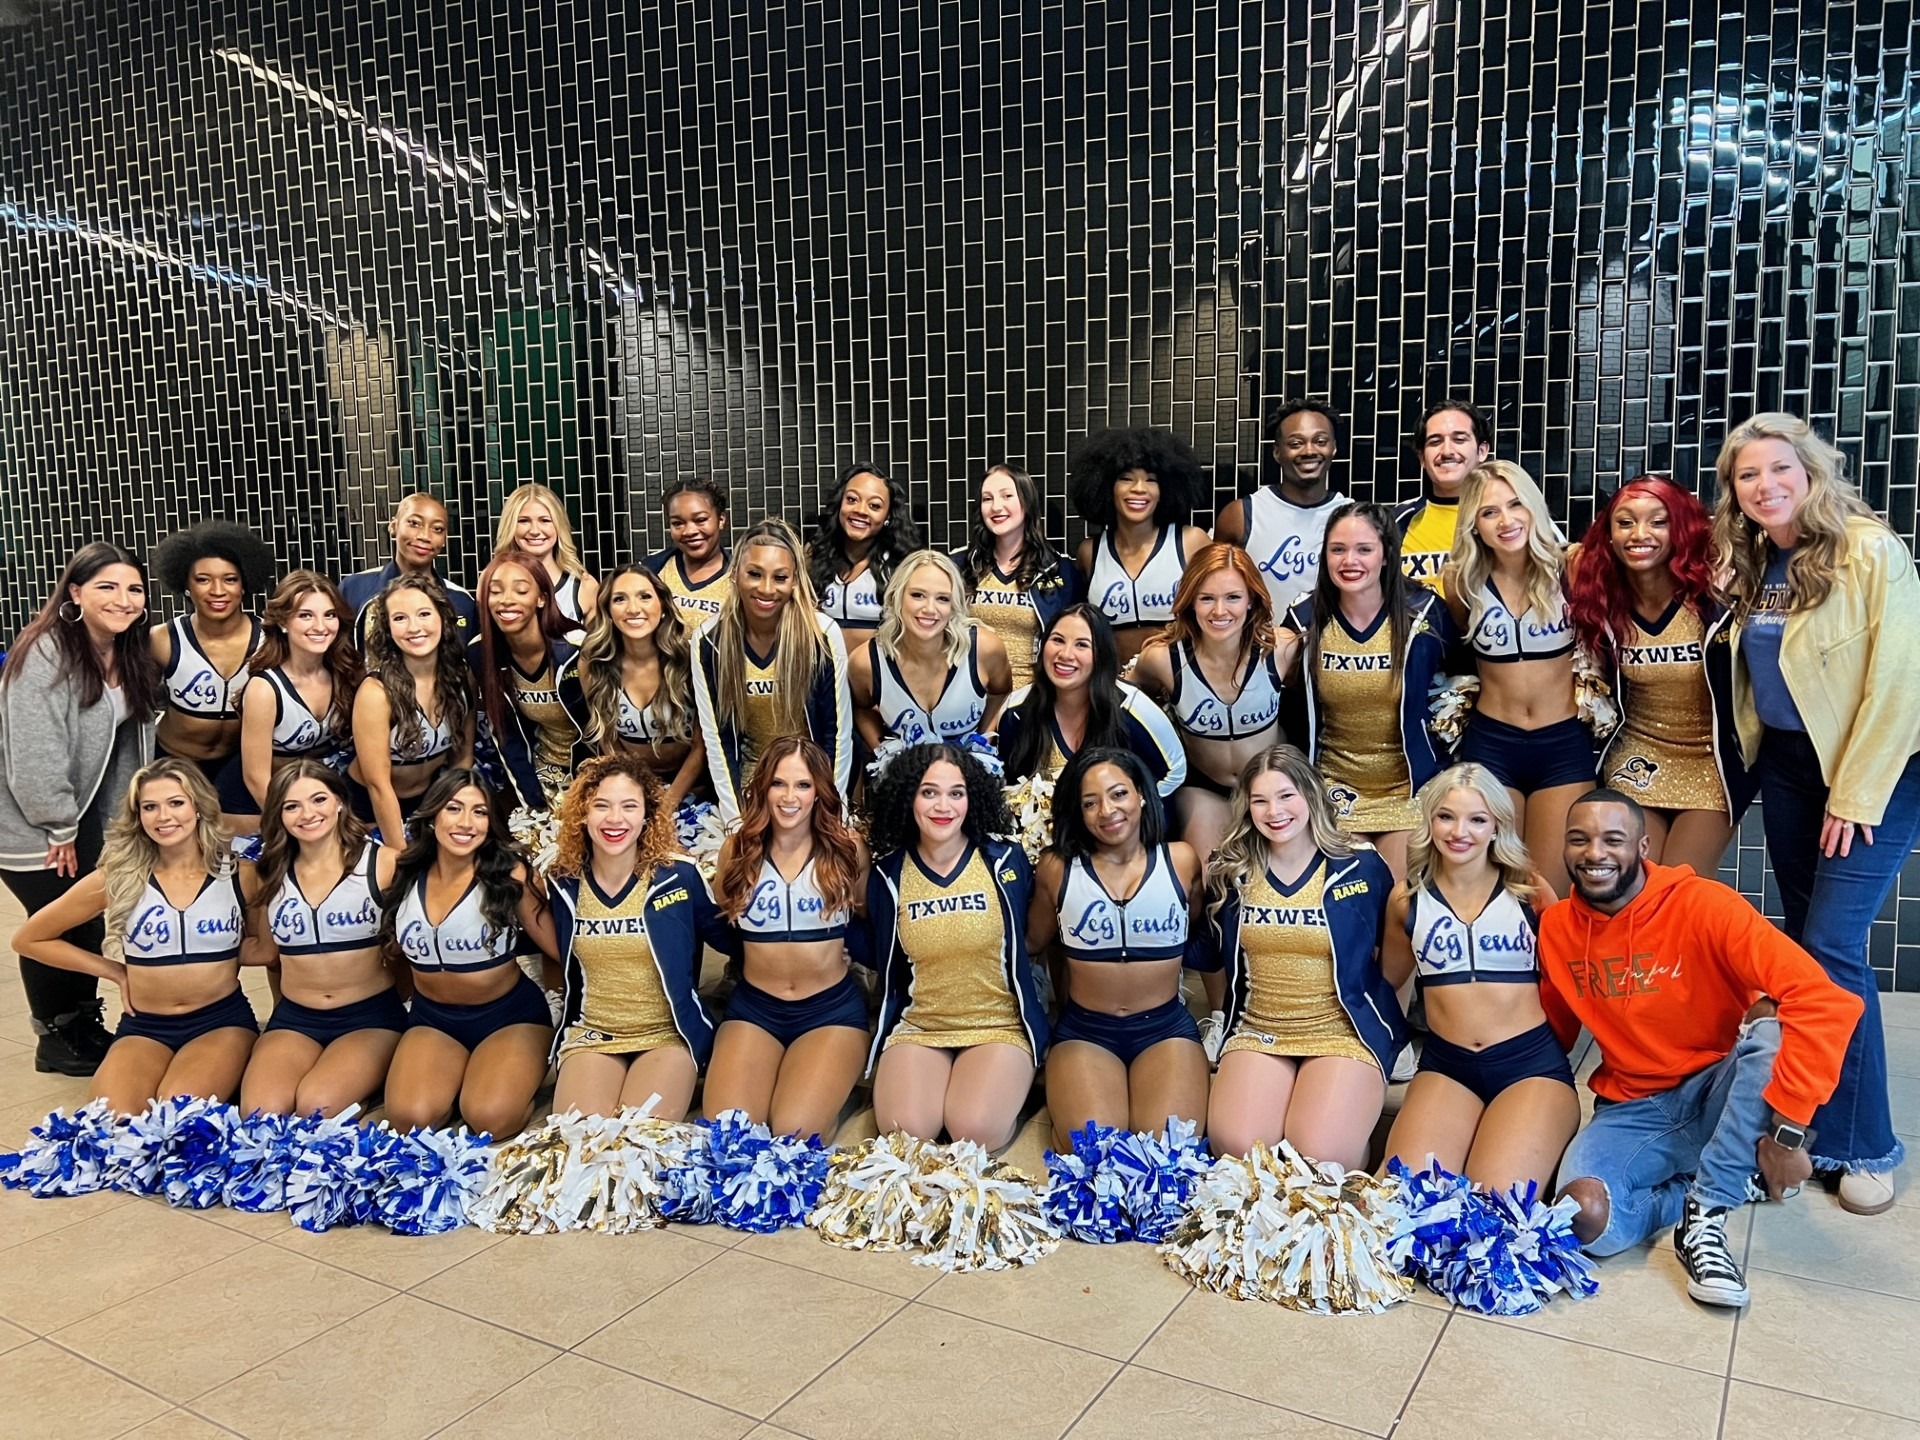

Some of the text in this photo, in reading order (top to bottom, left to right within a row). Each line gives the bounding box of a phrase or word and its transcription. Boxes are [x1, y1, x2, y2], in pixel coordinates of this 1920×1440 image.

[1258, 535, 1320, 581] Lege
[1322, 653, 1391, 671] TXWE
[652, 889, 688, 911] RAMS
[1332, 881, 1369, 901] RAMS
[908, 893, 987, 920] TXWES
[1567, 953, 1661, 998] FREE
